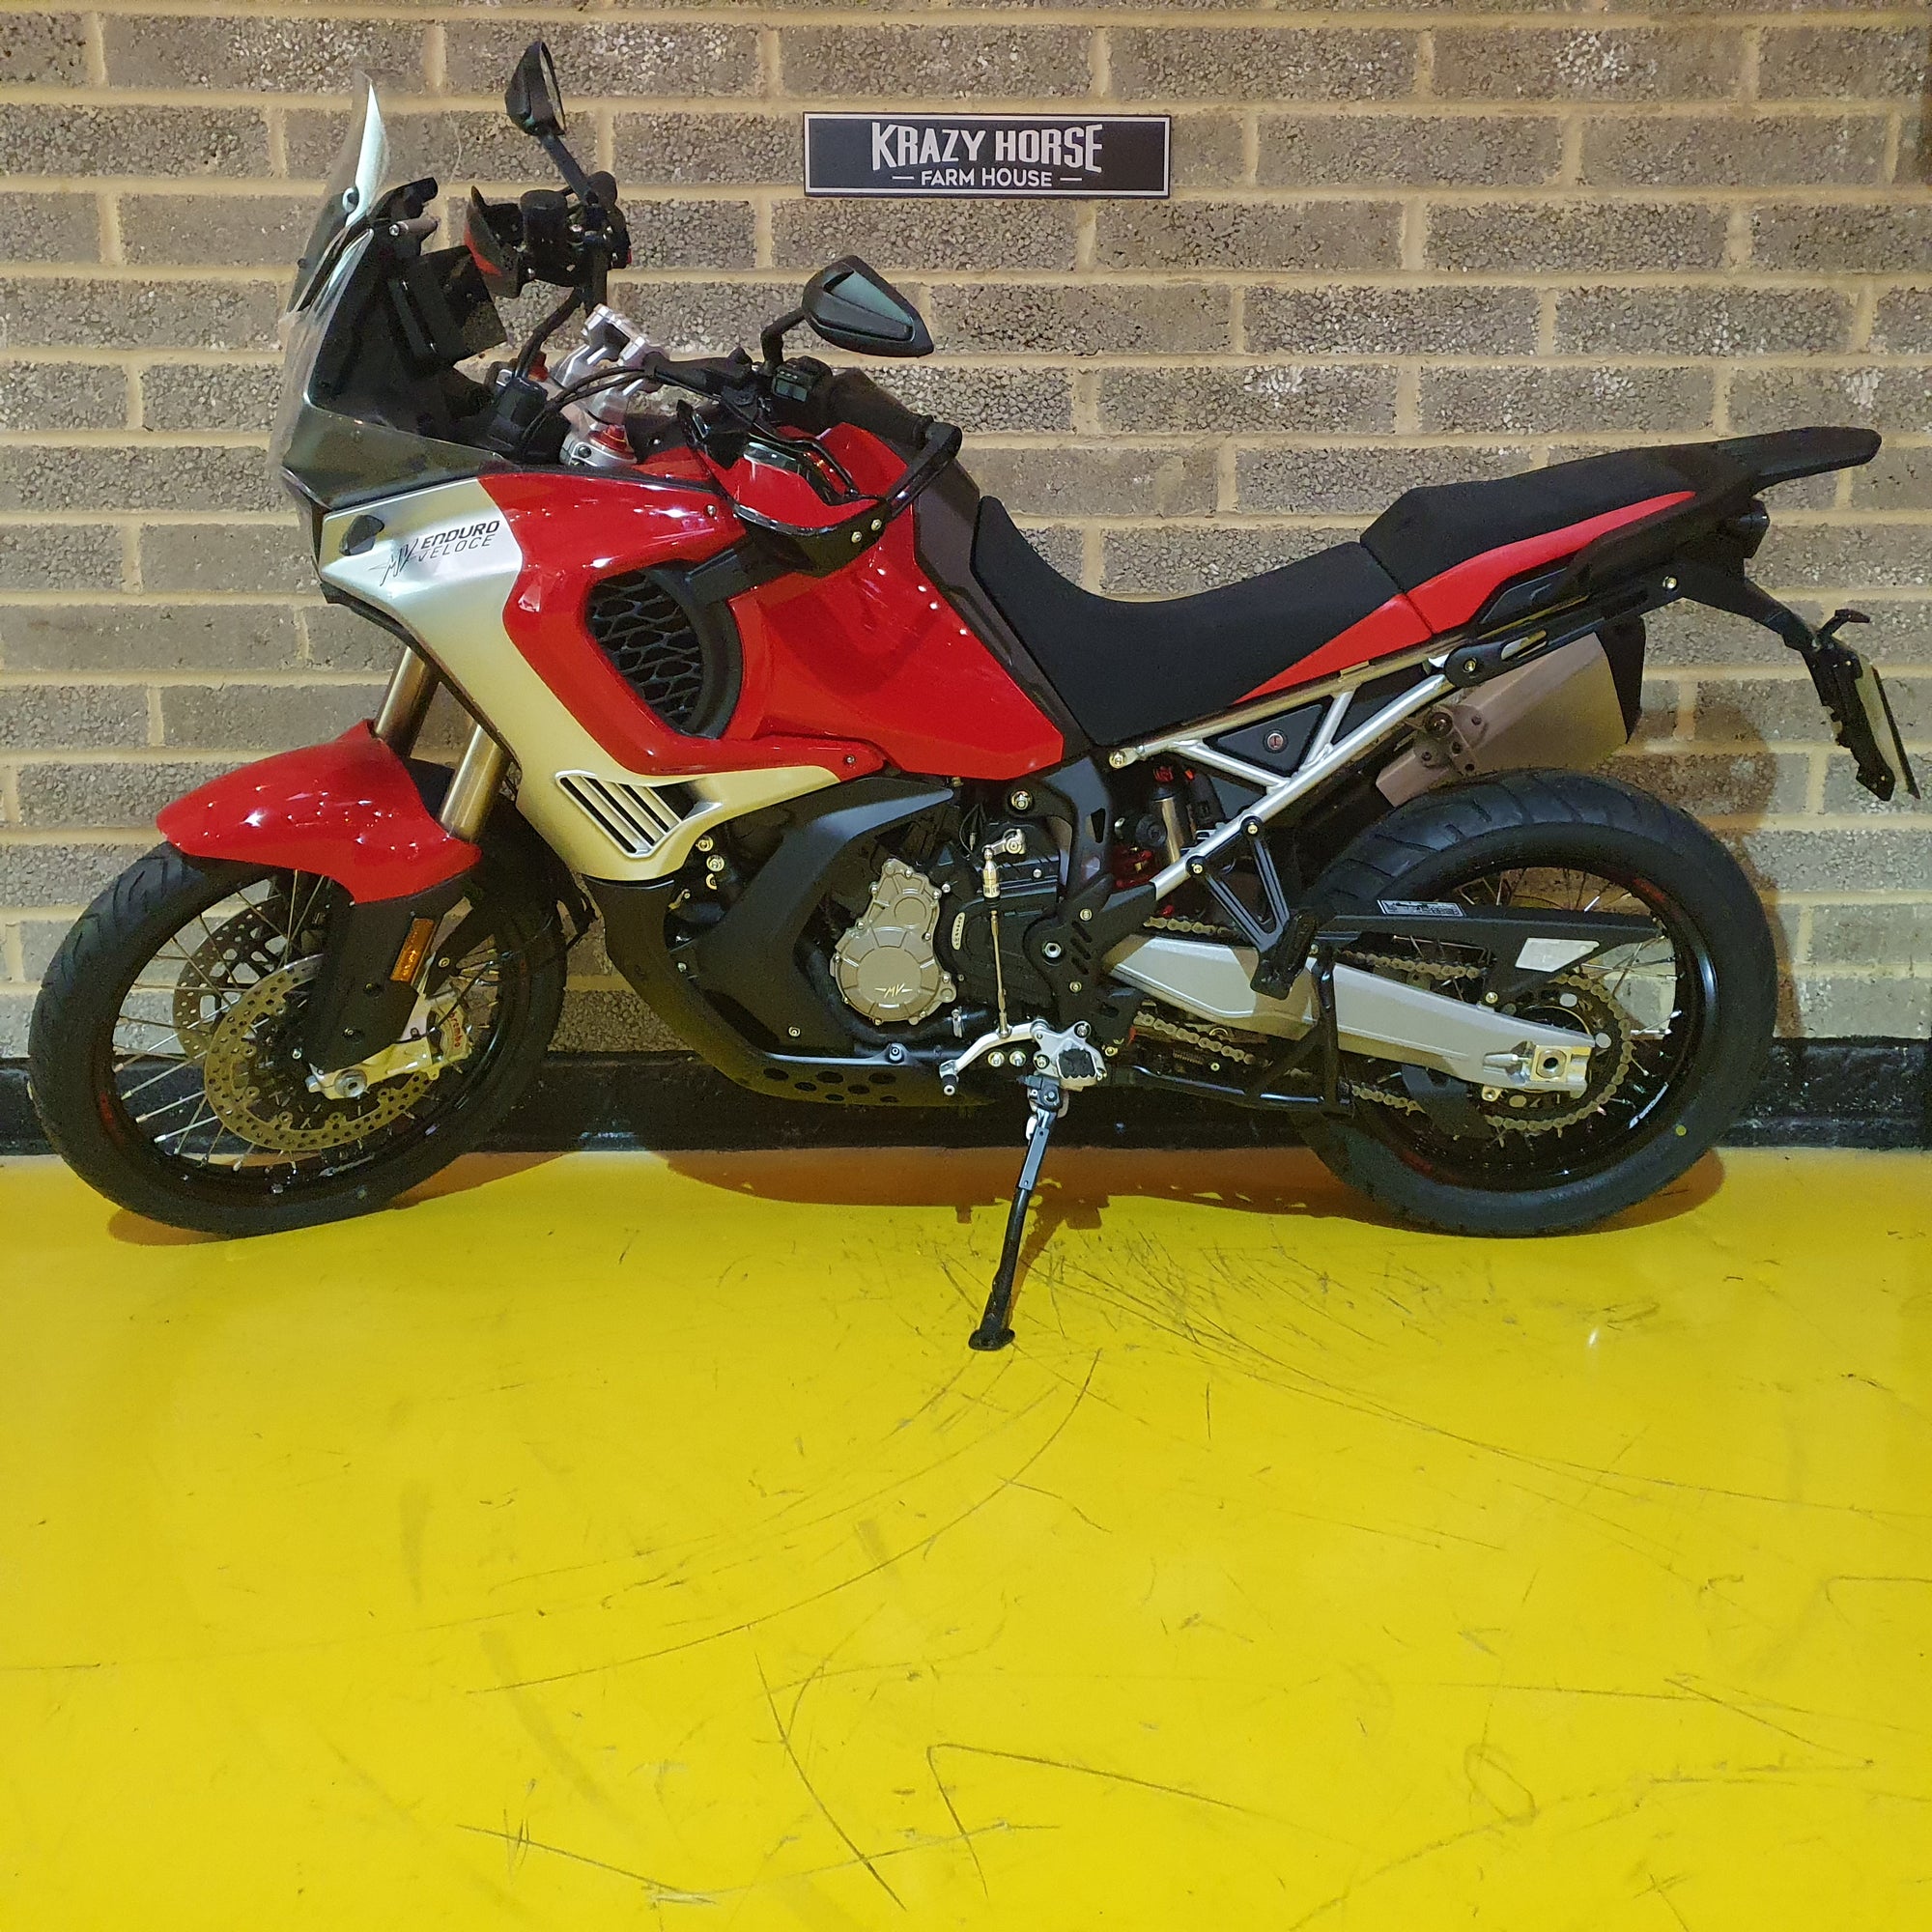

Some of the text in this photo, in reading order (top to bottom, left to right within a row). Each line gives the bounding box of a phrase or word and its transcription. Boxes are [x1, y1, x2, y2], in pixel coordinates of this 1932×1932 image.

[872, 122, 1103, 173] KRAZY HORSE
[921, 168, 1052, 188] FARM HOUSE
[419, 533, 496, 562] VELOCE
[420, 520, 500, 550] ENDURO
